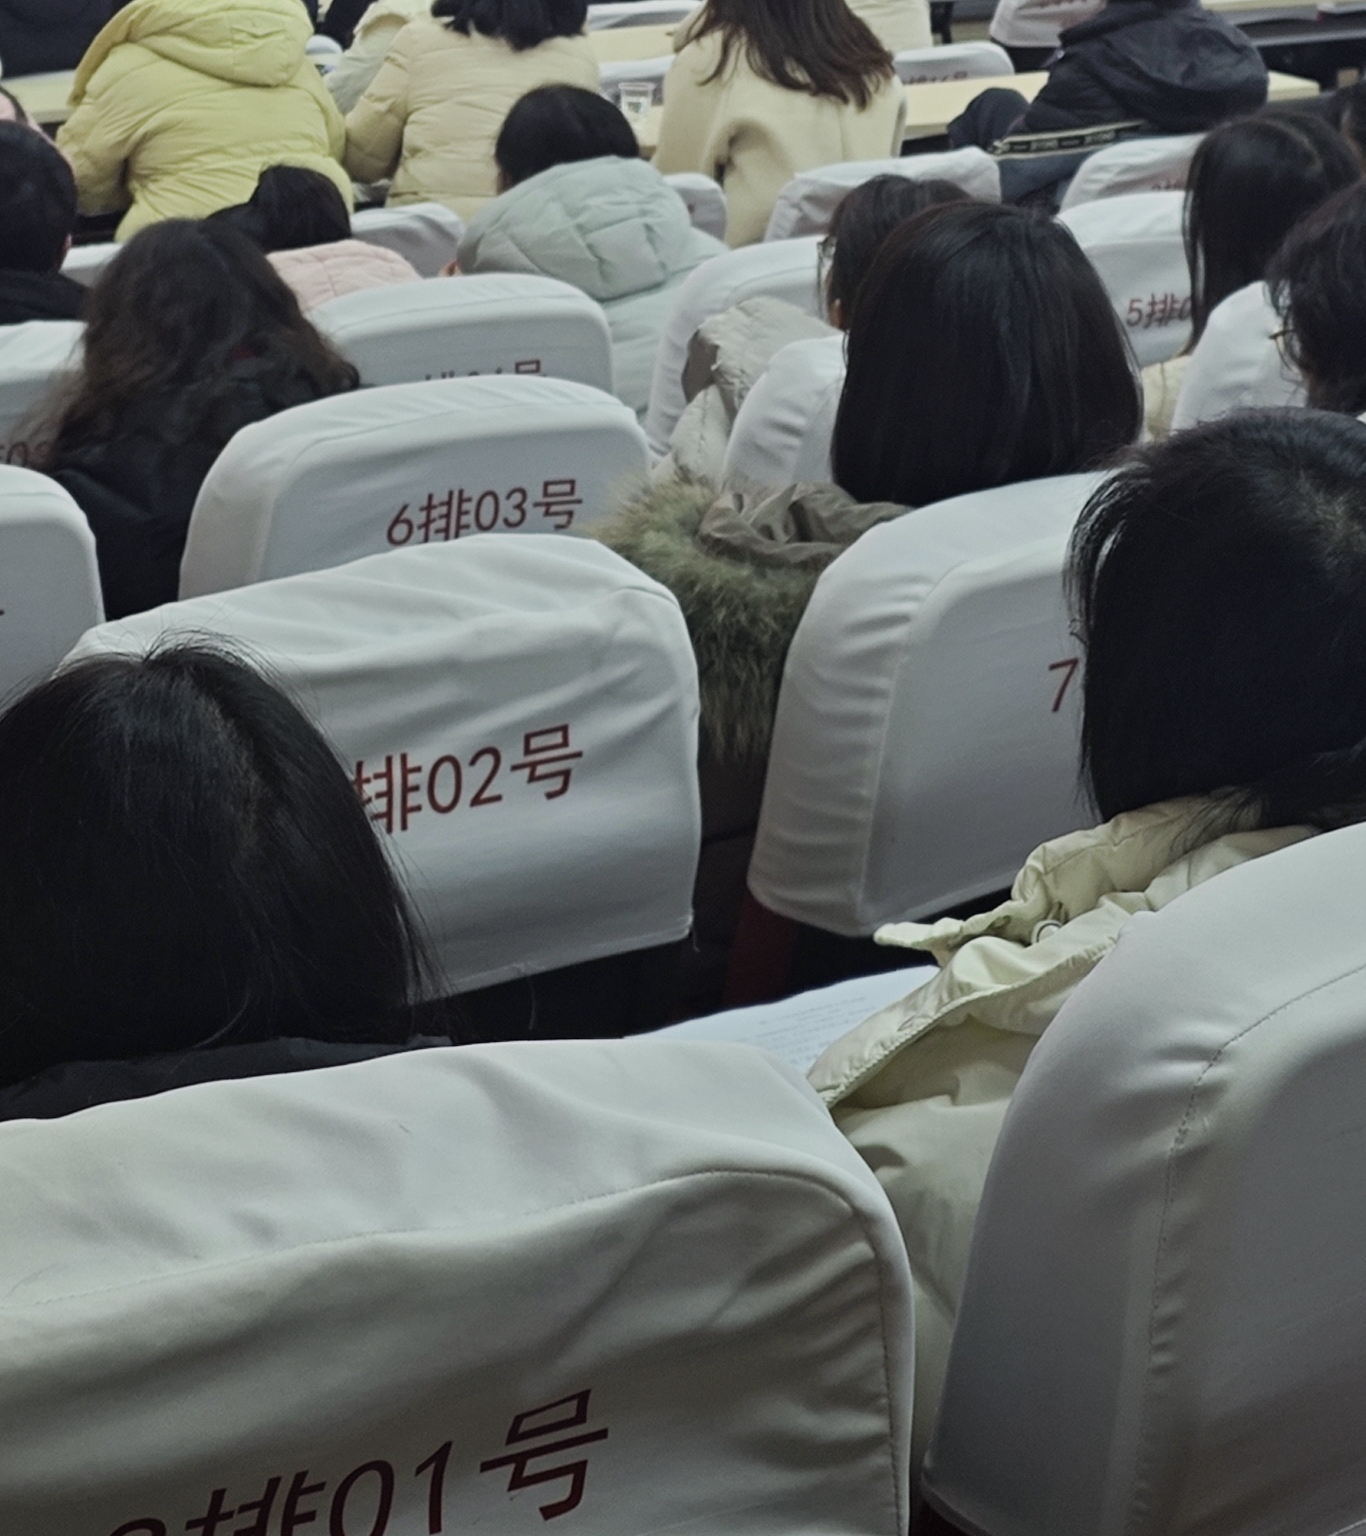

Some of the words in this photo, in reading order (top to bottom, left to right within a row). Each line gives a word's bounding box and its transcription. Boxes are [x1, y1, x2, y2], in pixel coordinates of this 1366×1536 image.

[1126, 293, 1192, 330] 5排0
[386, 479, 583, 546] 6排03号
[352, 723, 583, 834] 排02号
[109, 1388, 609, 1536] 排01号
